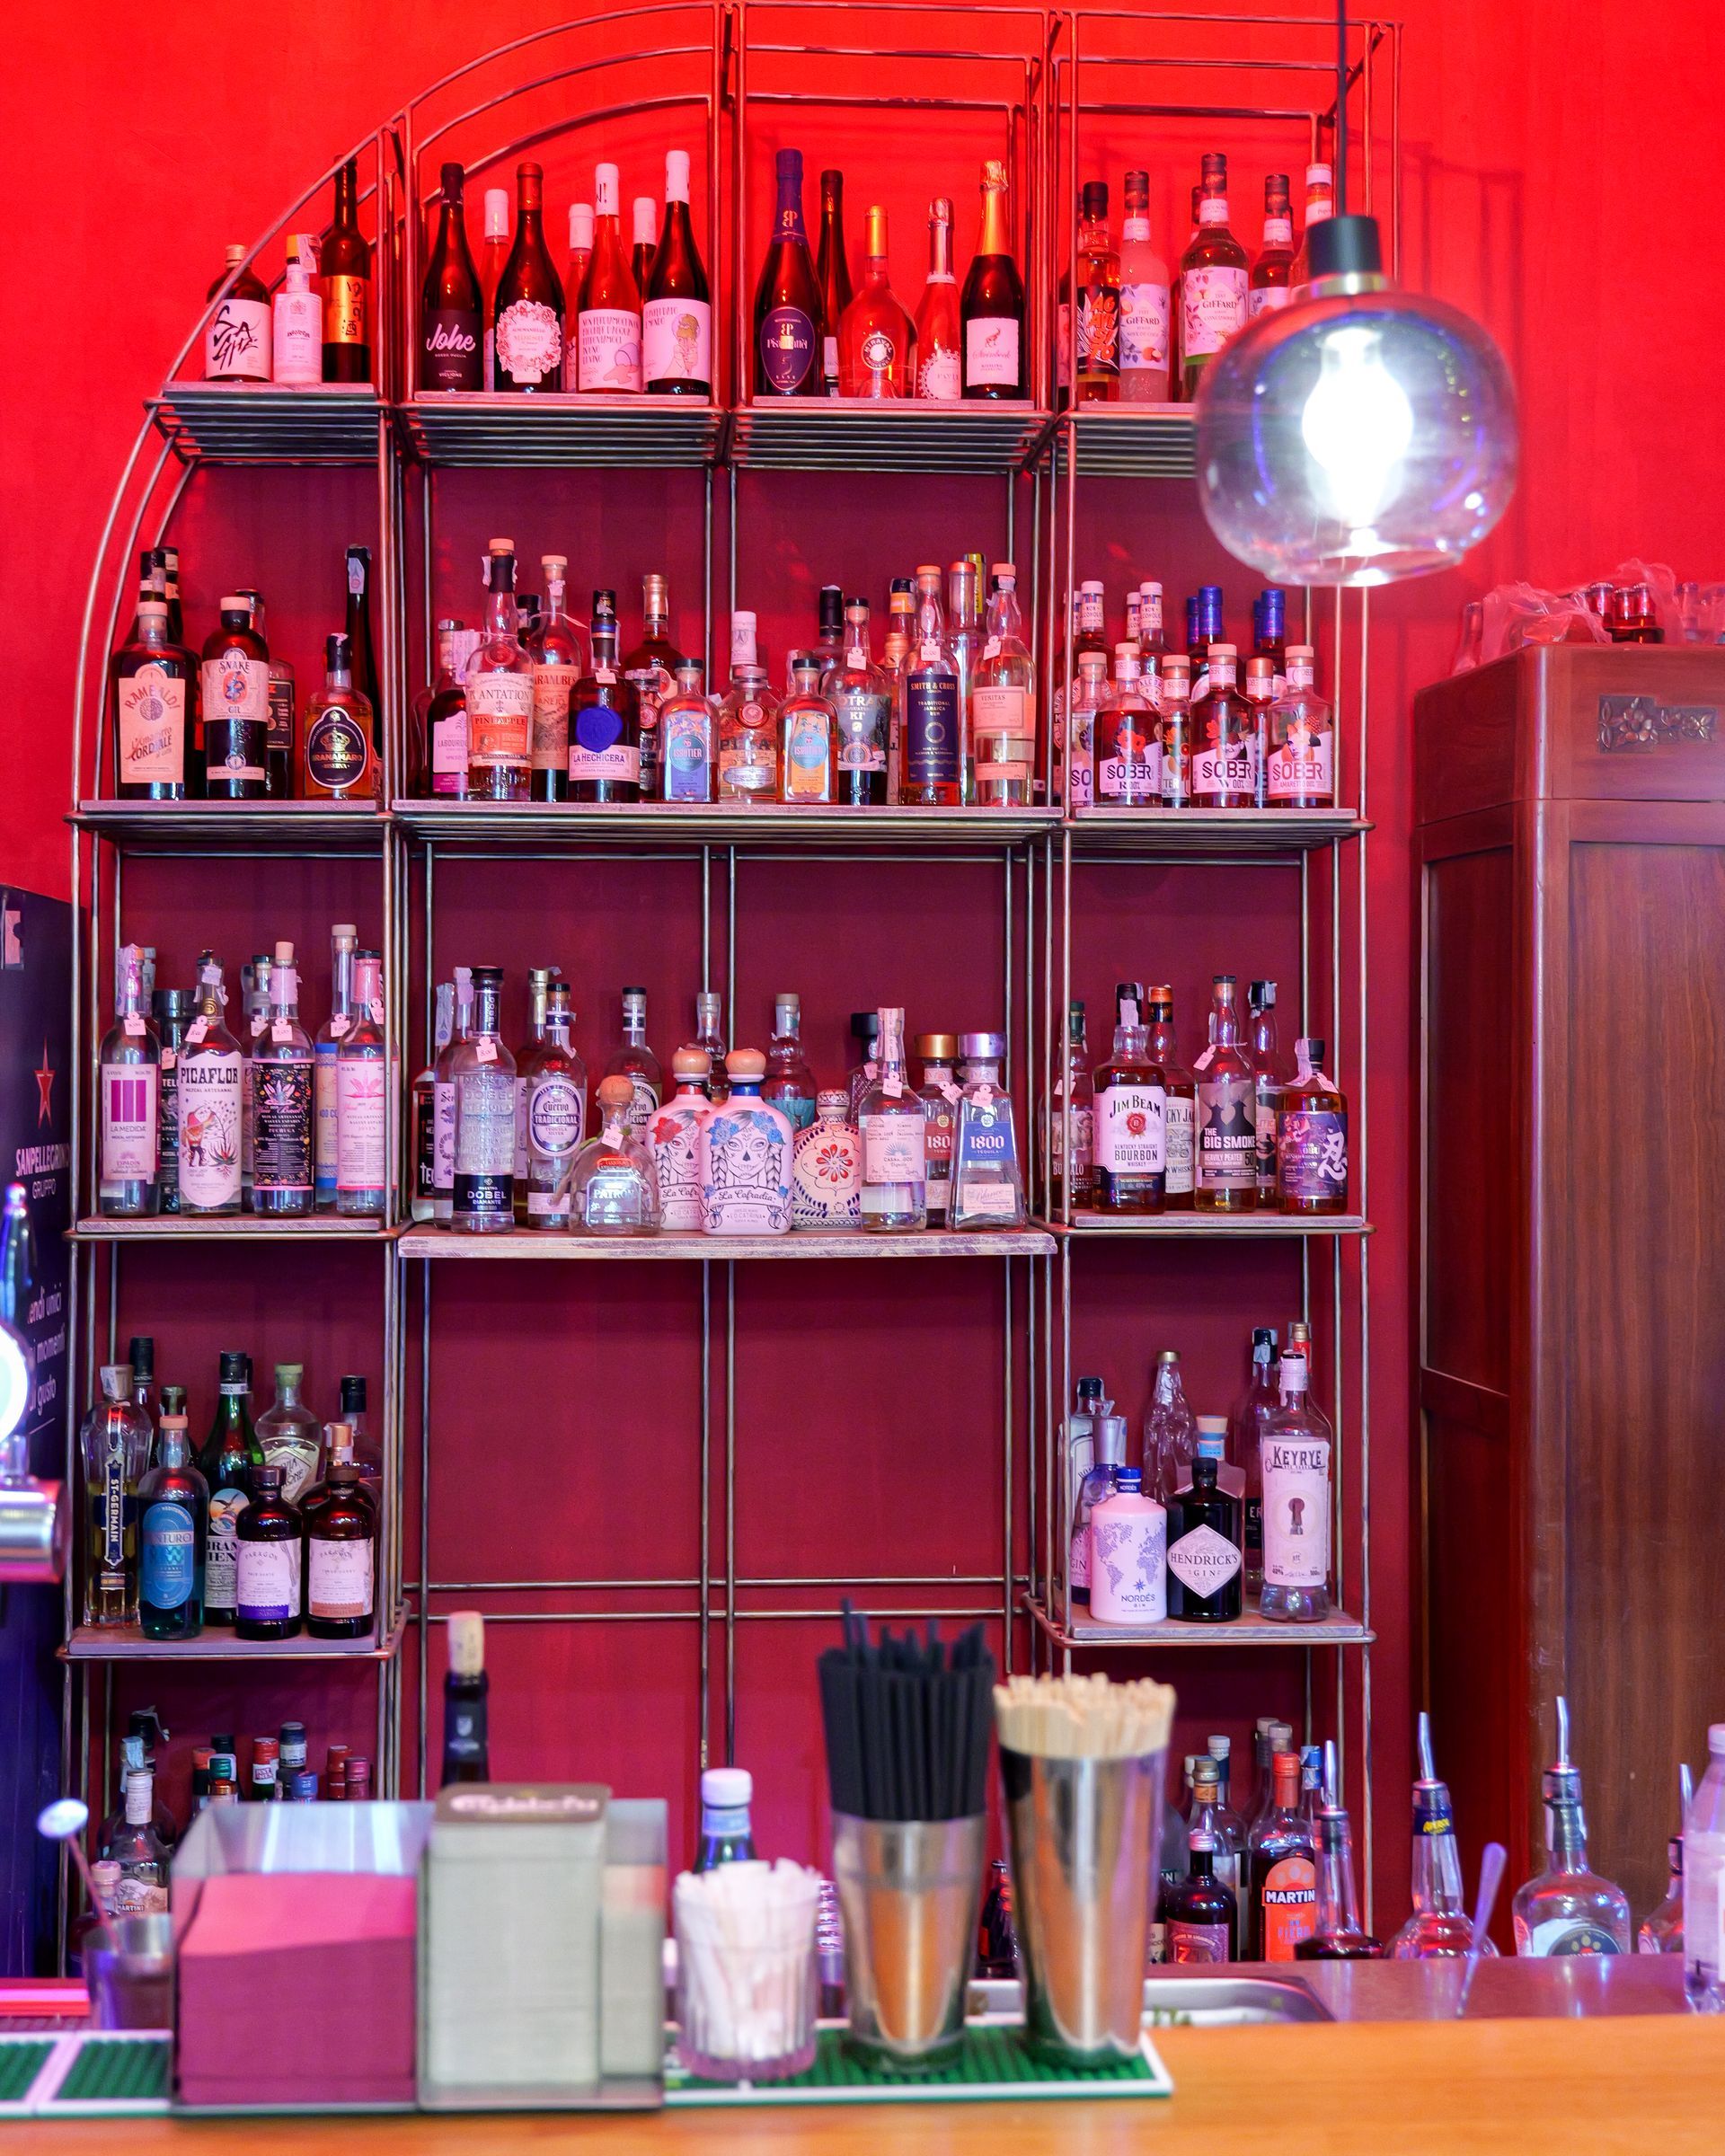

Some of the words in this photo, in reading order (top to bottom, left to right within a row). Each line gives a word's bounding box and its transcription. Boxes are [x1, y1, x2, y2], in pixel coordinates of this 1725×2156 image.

[1202, 300, 1238, 310] GIFFARD
[1126, 316, 1161, 325] GIFFARD
[218, 658, 251, 675] SNAKE
[910, 683, 931, 691] SMITH
[469, 688, 532, 702] PLANTATION
[581, 753, 626, 764] HECHICERA
[1106, 764, 1153, 781] SOBER
[1201, 760, 1252, 780] SOBER
[1272, 761, 1323, 782] SOBER
[181, 1065, 239, 1085] PICAFLOR
[542, 1100, 570, 1113] Cuervo
[1110, 1099, 1130, 1118] JIM
[1132, 1094, 1162, 1118] BEAM
[534, 1115, 579, 1125] TRADICIONAL
[1204, 1127, 1217, 1137] THE
[926, 1135, 951, 1150] 180
[970, 1135, 1005, 1150] 1800
[1203, 1135, 1223, 1149] BIG
[1114, 1149, 1159, 1162] BOURBON
[719, 1188, 734, 1200] La
[1273, 1445, 1322, 1466] KEYRYE
[110, 1478, 120, 1543] ST-GERMAIN
[1170, 1551, 1239, 1566] HENDRICK'S
[1193, 1569, 1216, 1577] GIN
[1120, 1592, 1157, 1604] NORDÉS
[1265, 1889, 1315, 1904] MARTIN
